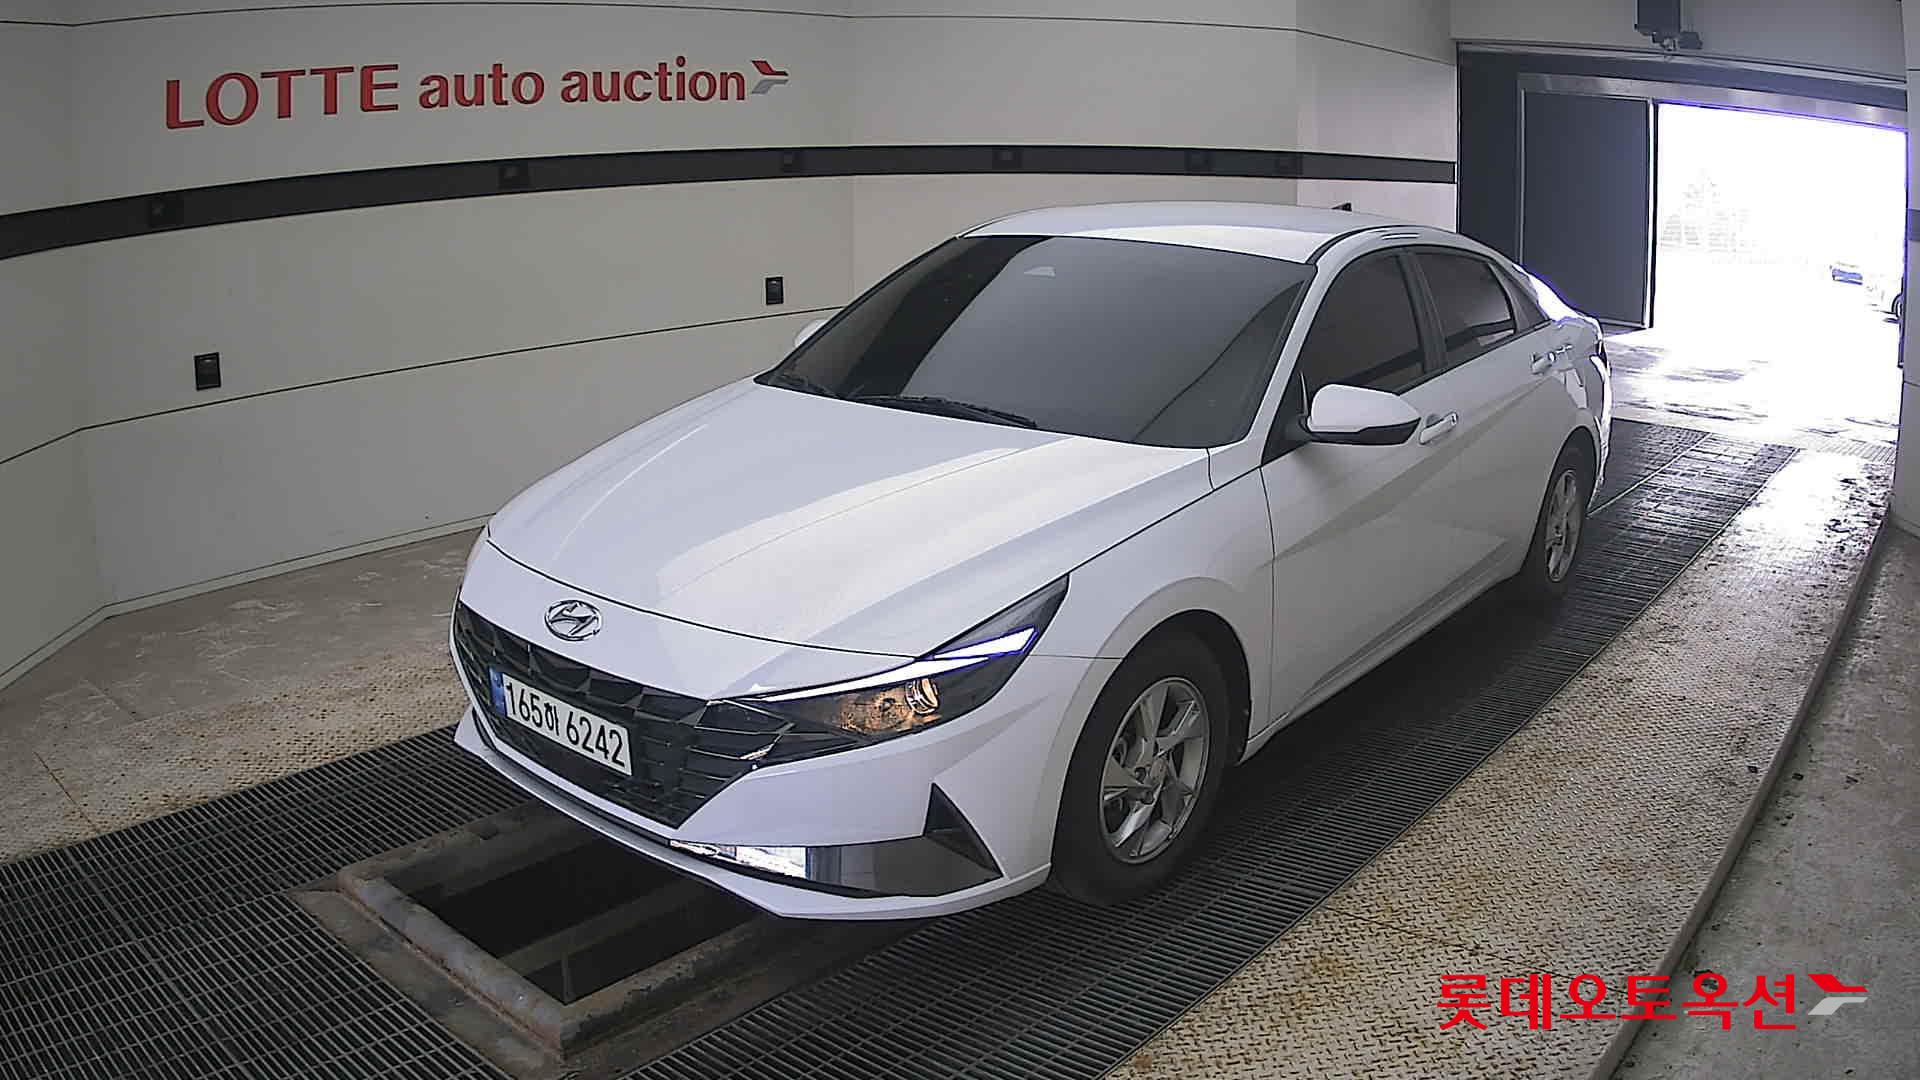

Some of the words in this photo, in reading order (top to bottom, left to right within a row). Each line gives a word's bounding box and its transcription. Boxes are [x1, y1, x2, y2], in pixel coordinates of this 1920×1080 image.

[166, 63, 399, 129] LOTTE
[419, 62, 545, 109] auto
[560, 56, 746, 103] auction
[566, 711, 625, 768] 6242
